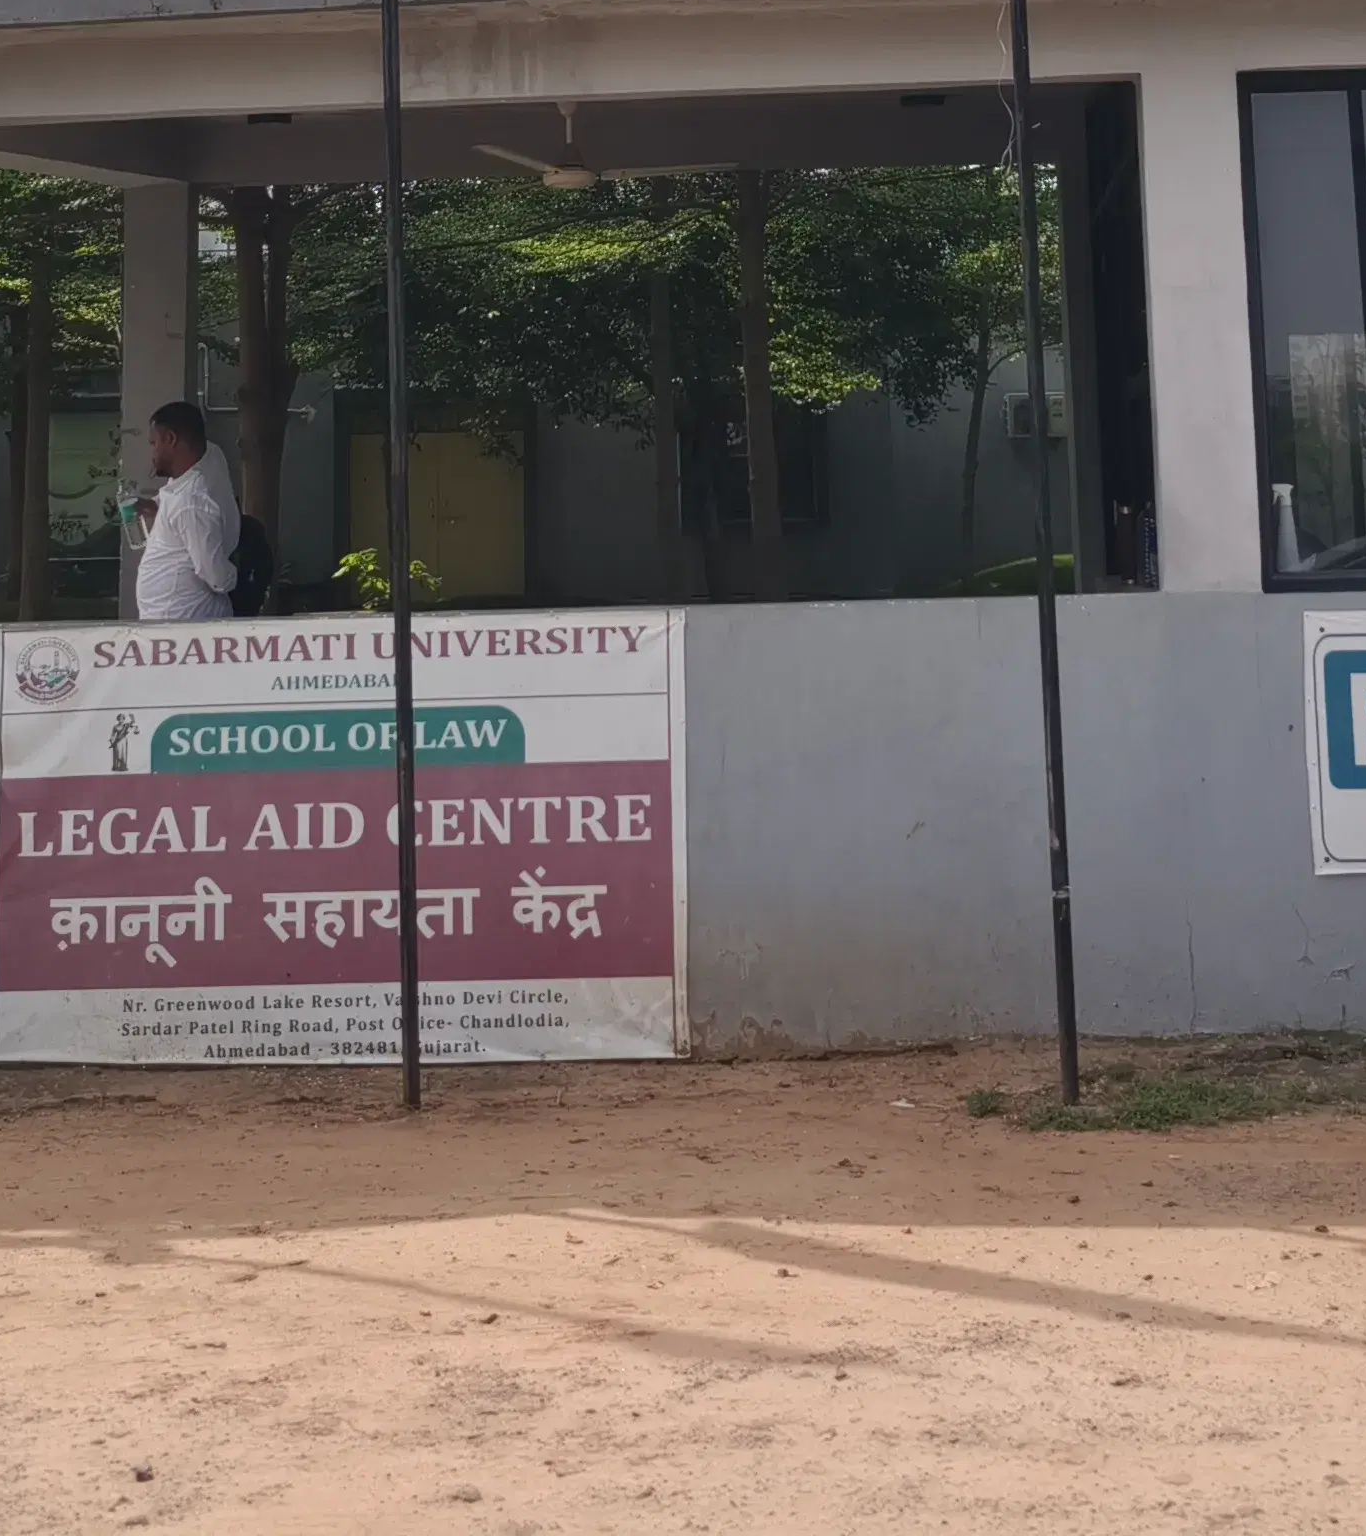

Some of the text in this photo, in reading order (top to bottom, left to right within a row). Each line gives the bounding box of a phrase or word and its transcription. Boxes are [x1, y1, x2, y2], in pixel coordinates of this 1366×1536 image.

[92, 625, 647, 668] SABARMATI UNIVERSITY
[270, 672, 397, 692] AHMEDABA
[168, 718, 508, 757] SCHOOL OF LAW
[18, 794, 652, 858] LEGAL AID CENTRE
[262, 887, 481, 948] सहायता
[511, 866, 608, 939] केंद्र
[123, 989, 570, 1013] Nr. Greenwood Lake Resort, Vahno Devi Circle,
[121, 1012, 570, 1037] Sardar Patel Ring Road, Post Oice- Chandlodia,
[203, 1041, 312, 1058] Ahmedabad
[418, 1039, 487, 1057] ujarat.
